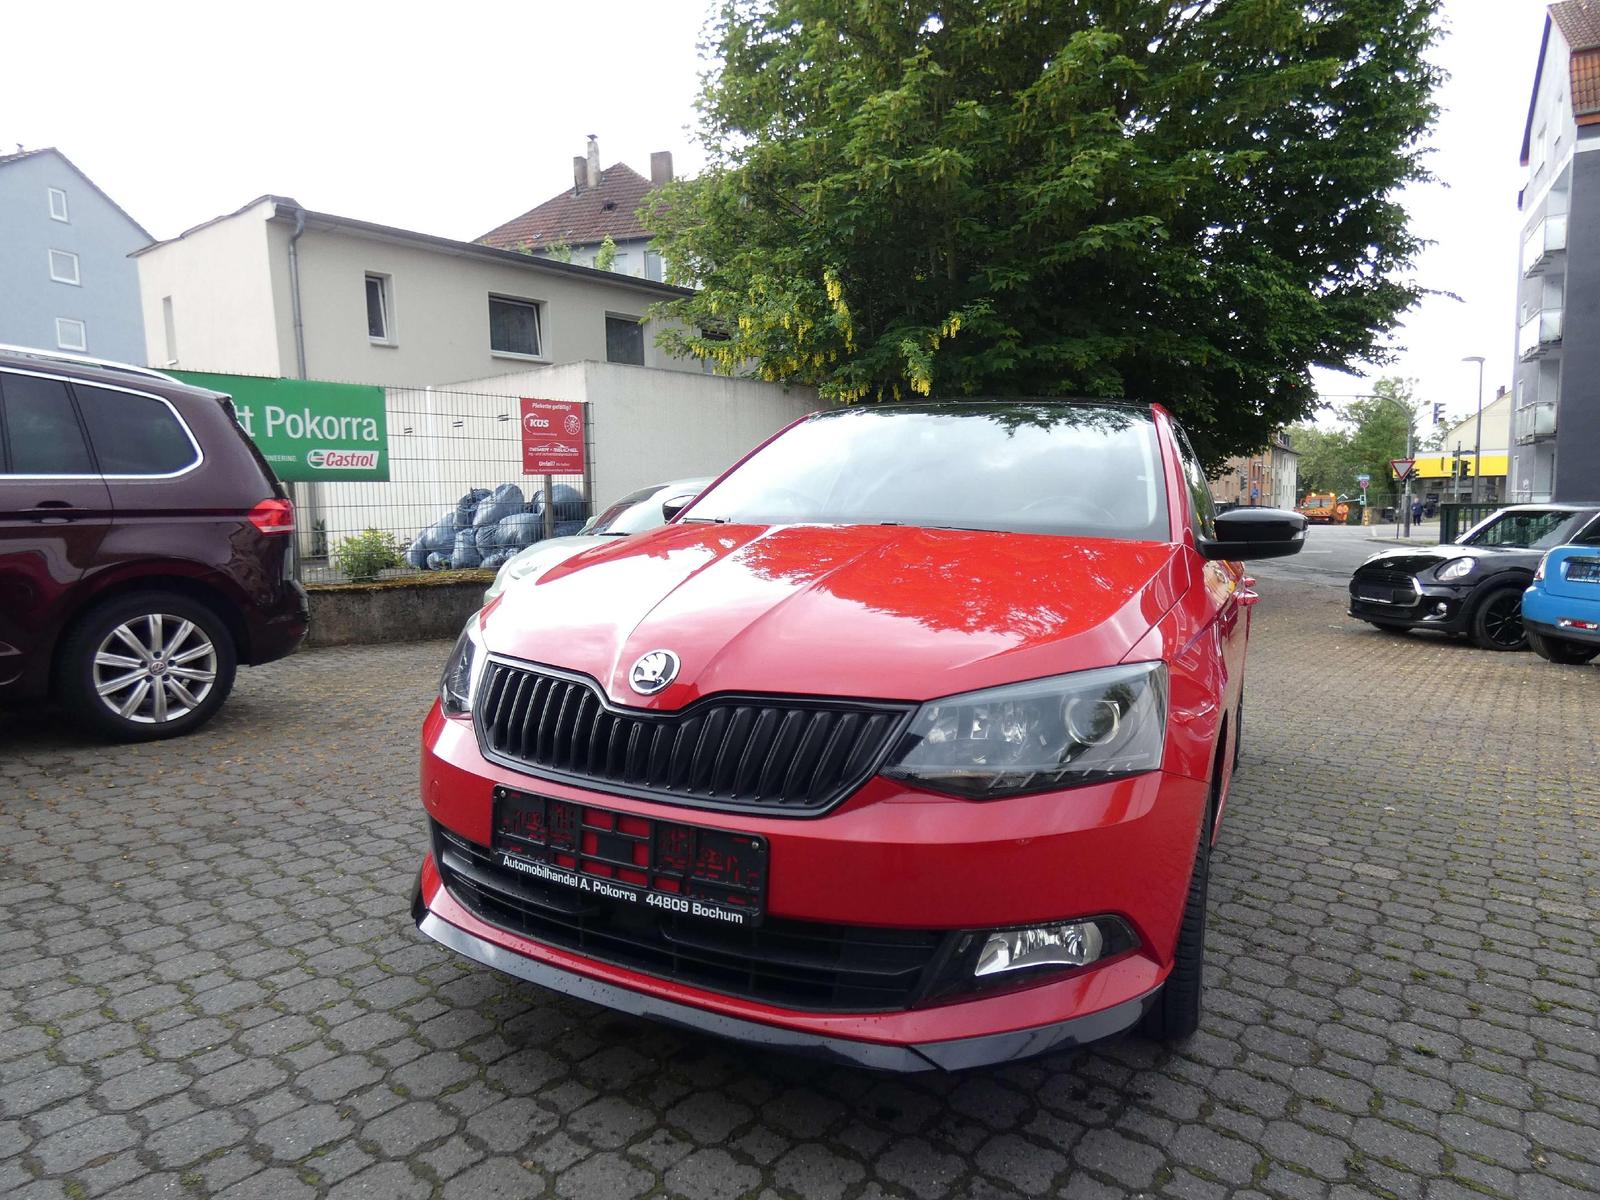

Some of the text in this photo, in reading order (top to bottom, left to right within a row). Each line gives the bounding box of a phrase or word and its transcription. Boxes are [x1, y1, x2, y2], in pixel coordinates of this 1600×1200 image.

[264, 405, 379, 441] Pokorra
[325, 451, 374, 467] Castrol
[503, 855, 743, 924] Automobilhandel A. Pokorra 44809 Bochum
